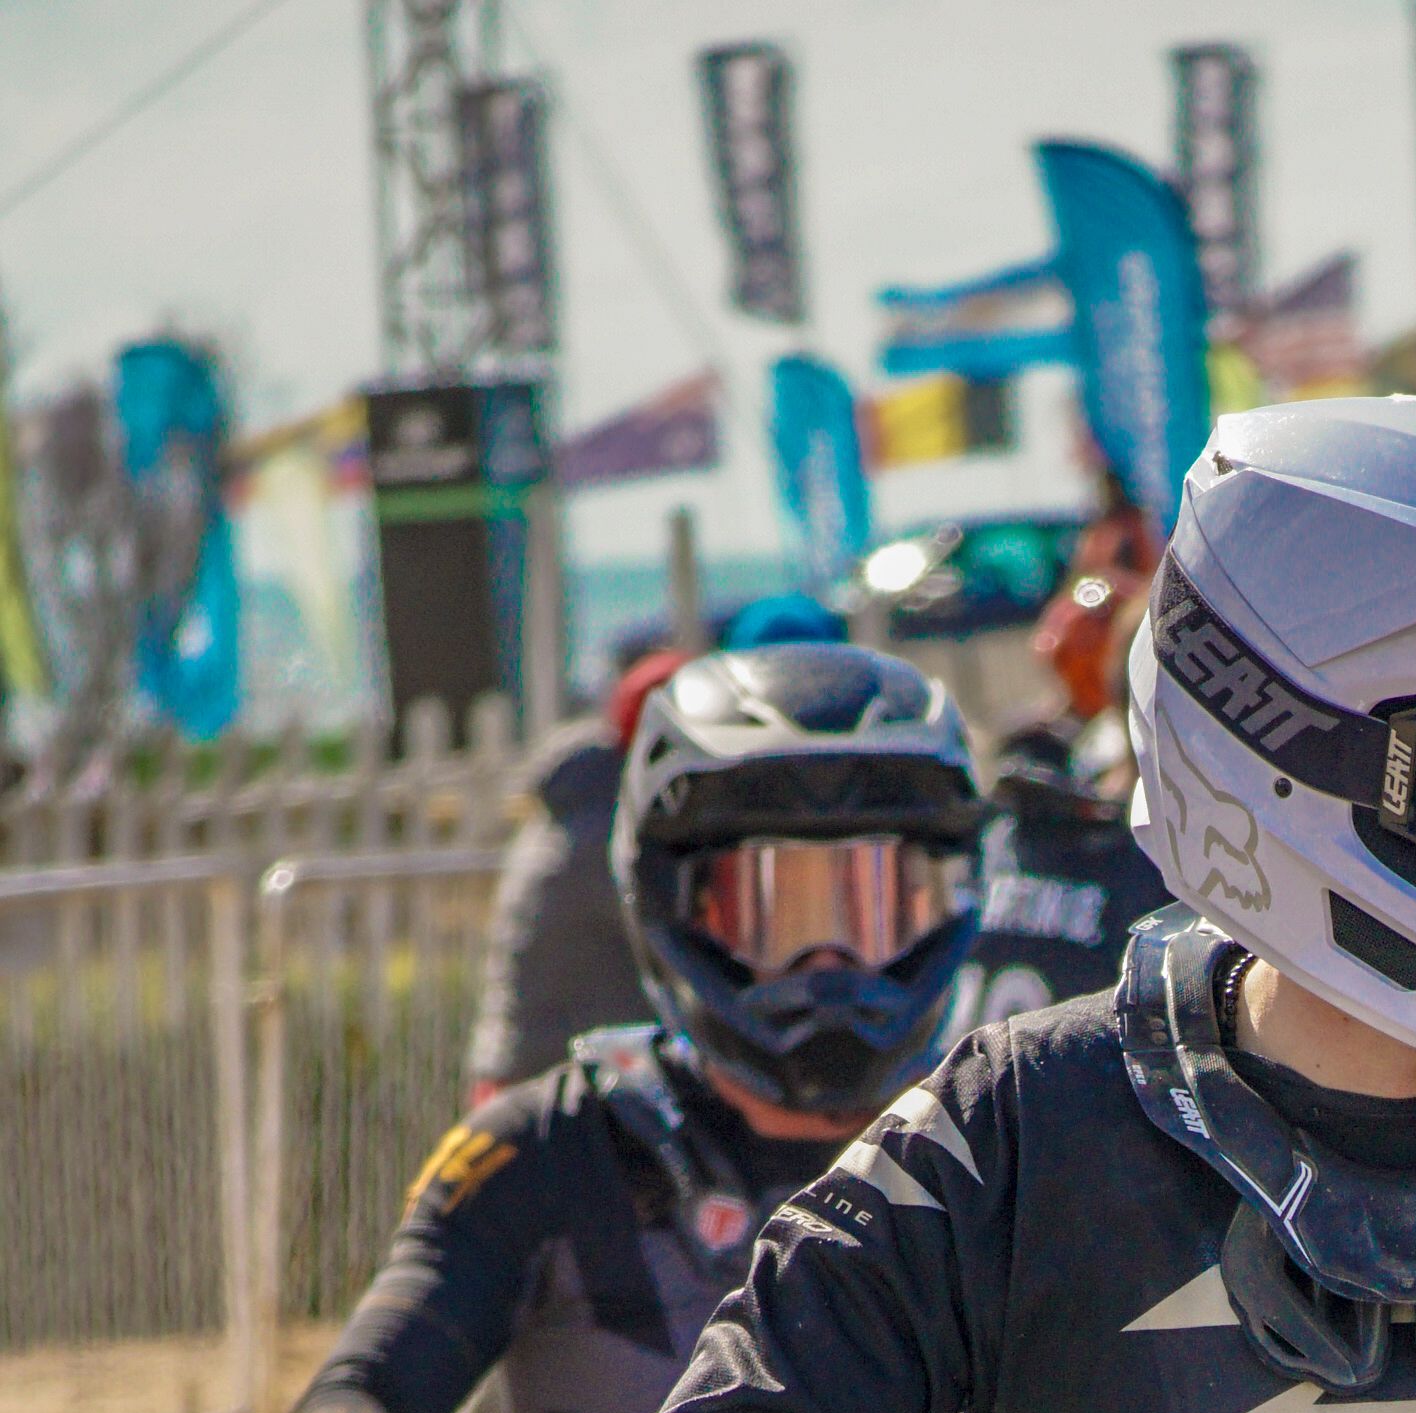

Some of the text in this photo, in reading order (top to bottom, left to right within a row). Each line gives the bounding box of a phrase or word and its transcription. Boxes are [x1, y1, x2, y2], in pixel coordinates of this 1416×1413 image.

[1154, 600, 1341, 752] LEATT
[1383, 728, 1413, 817] LEATT
[1169, 1087, 1210, 1139] LEATT
